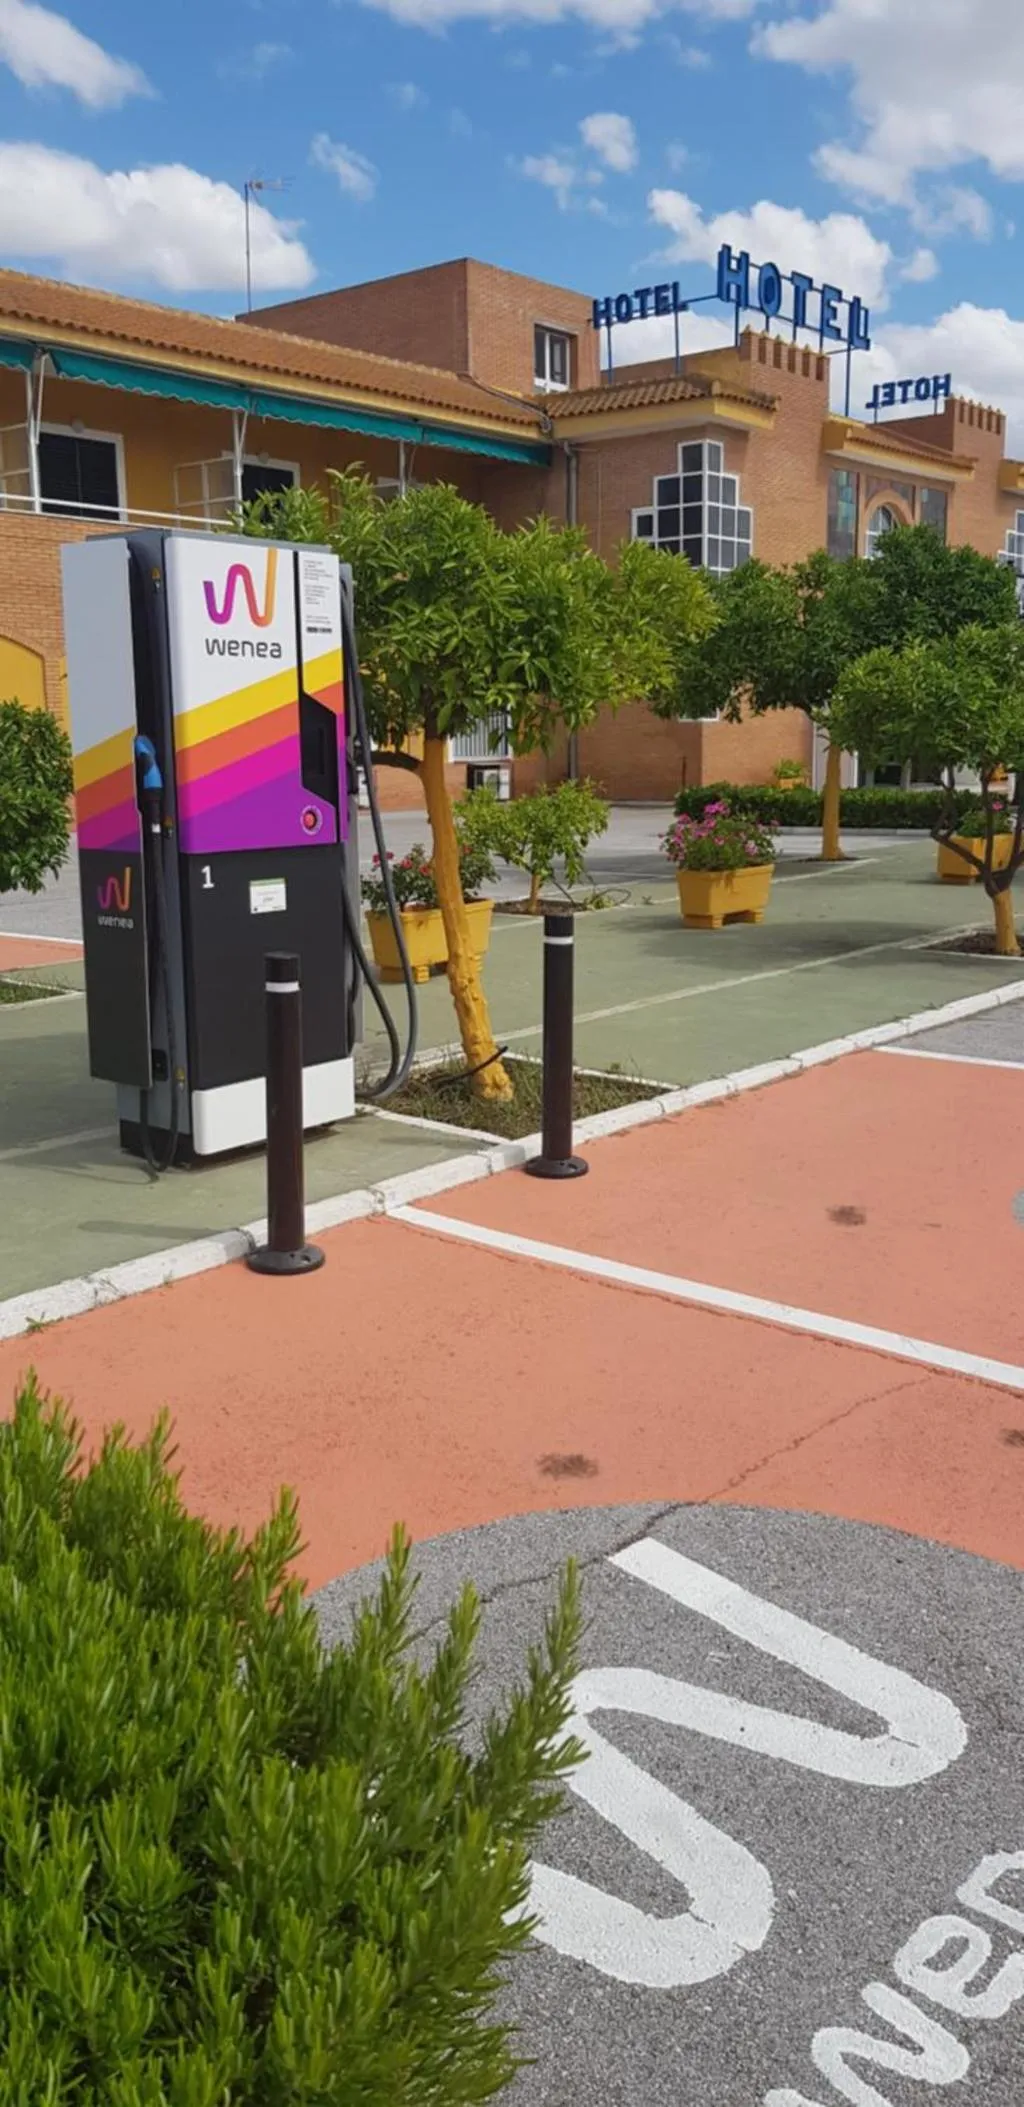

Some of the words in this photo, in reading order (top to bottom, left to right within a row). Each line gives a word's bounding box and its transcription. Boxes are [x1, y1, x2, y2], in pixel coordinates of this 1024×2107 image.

[592, 281, 689, 330] HOTEL
[717, 243, 870, 350] HOTEL
[205, 638, 282, 659] wenea
[201, 865, 215, 889] 1
